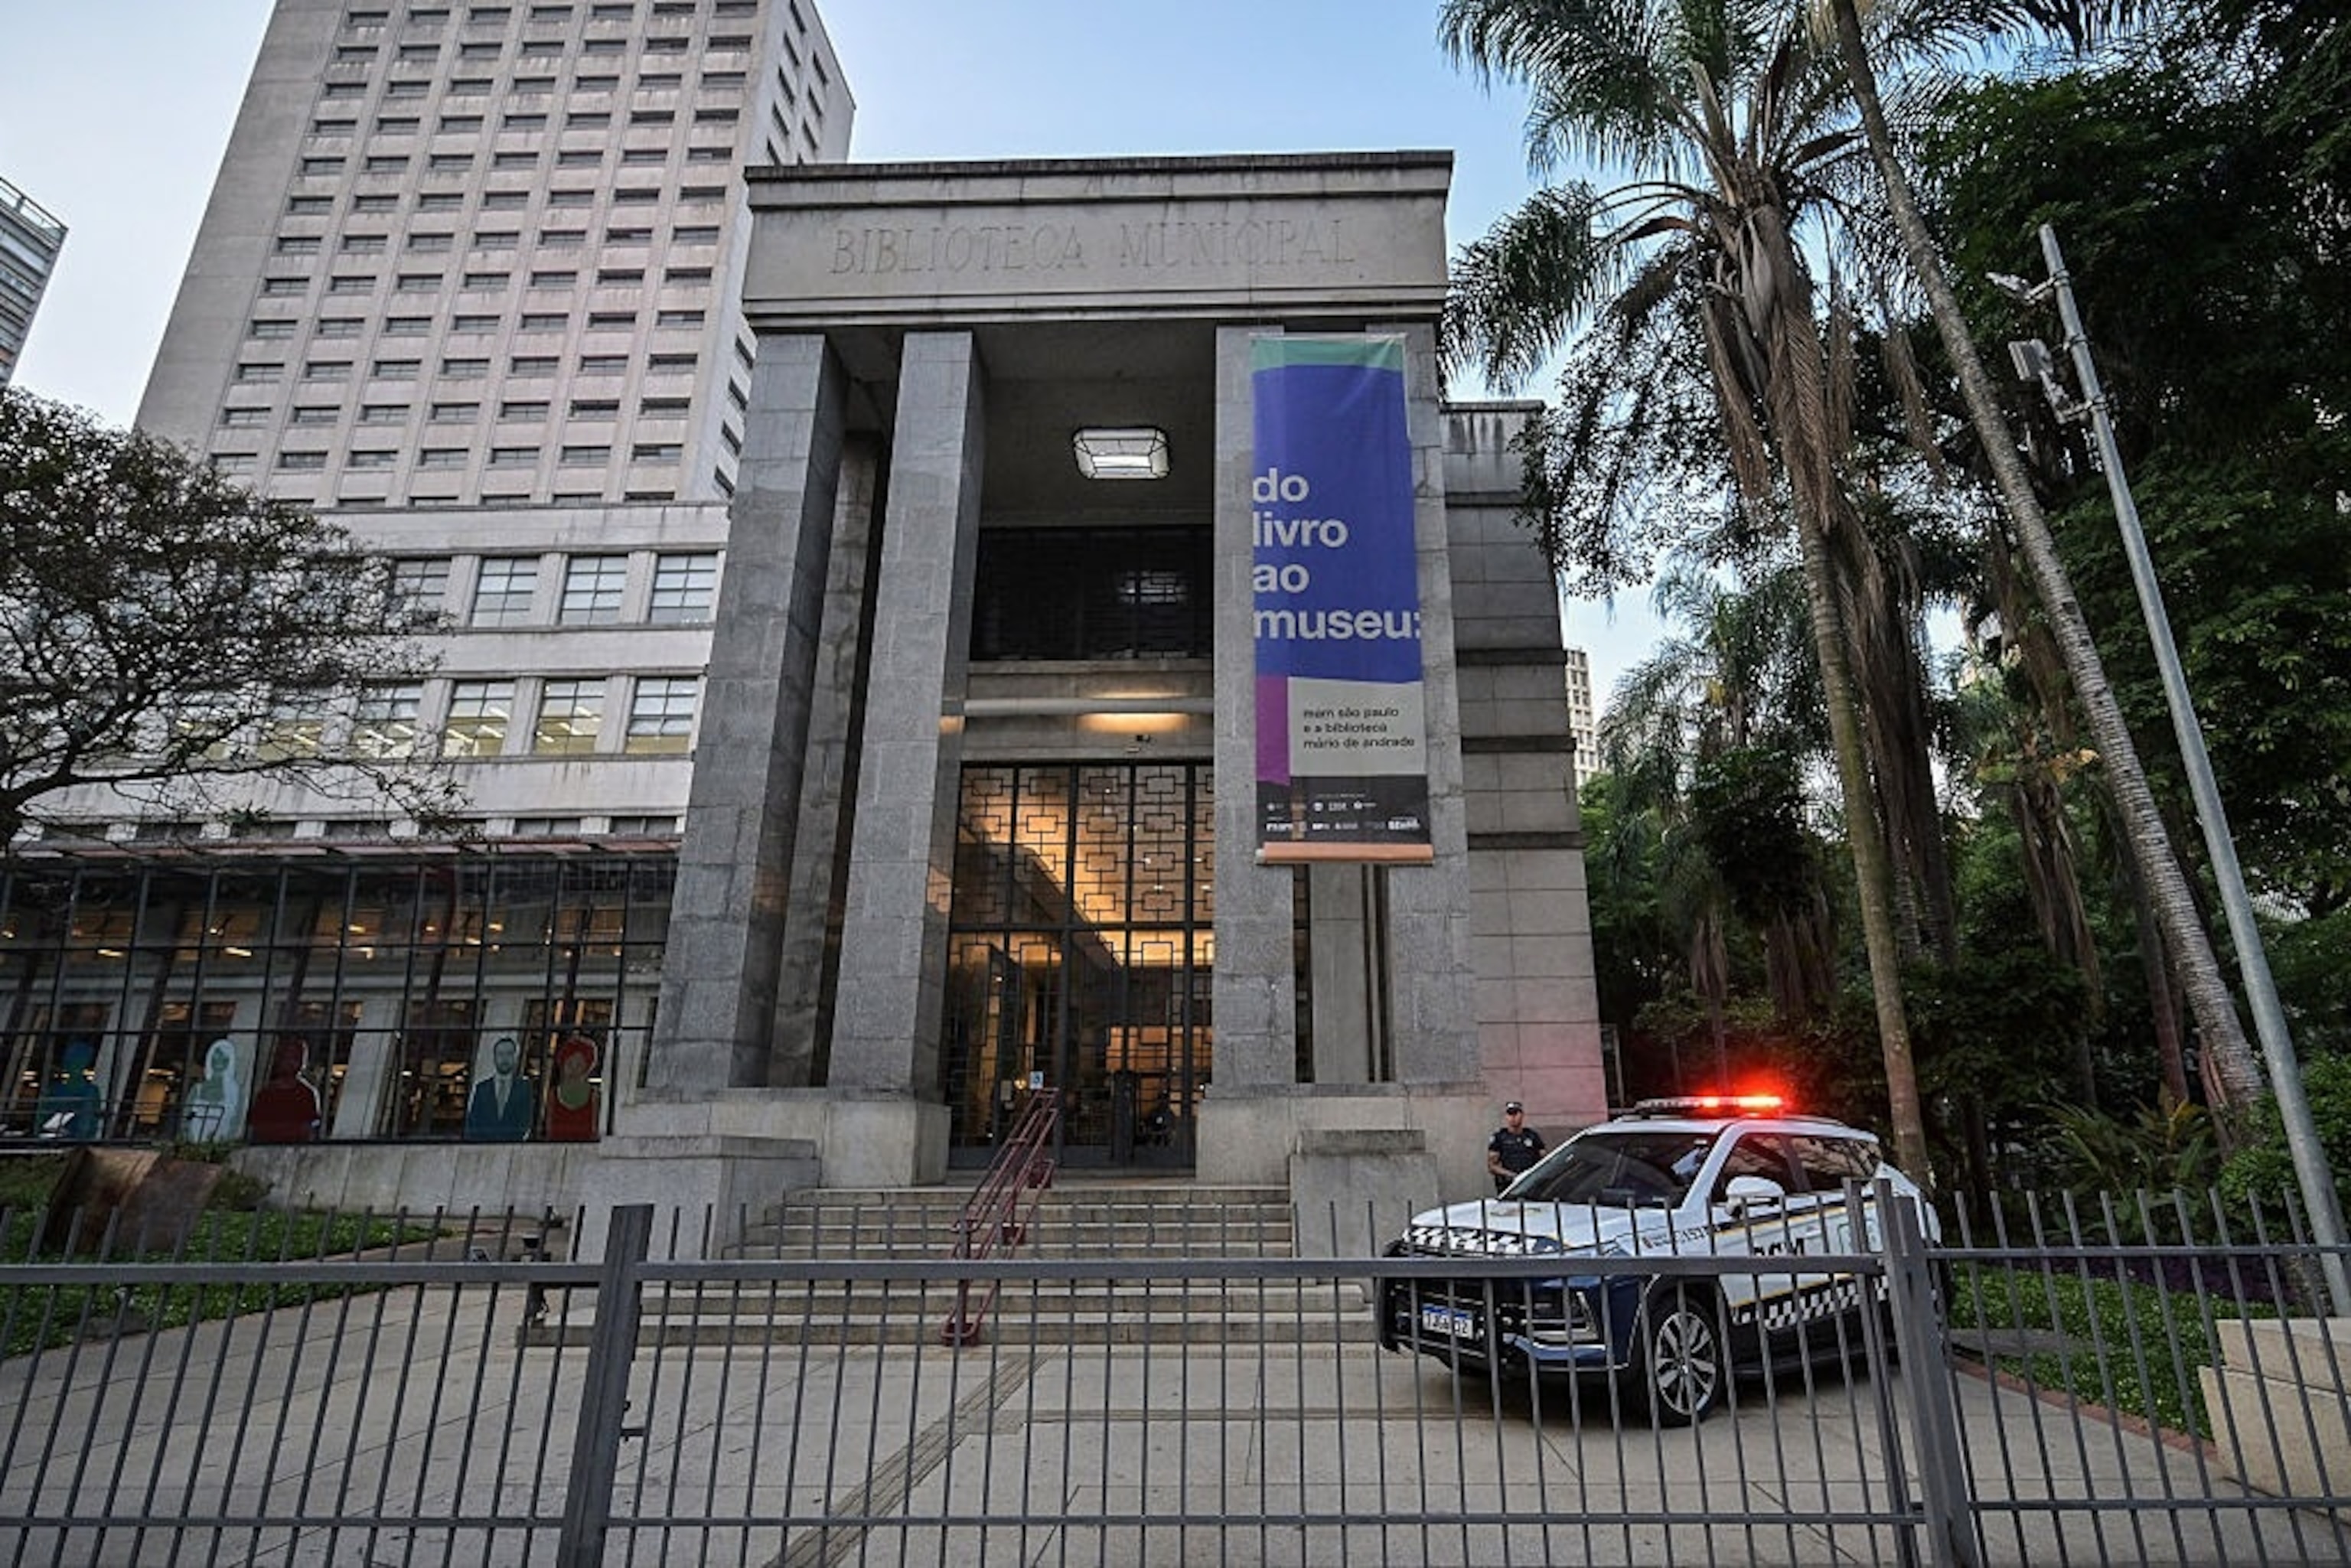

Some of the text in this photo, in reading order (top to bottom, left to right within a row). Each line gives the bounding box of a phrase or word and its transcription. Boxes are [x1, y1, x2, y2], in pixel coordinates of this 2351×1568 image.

[830, 219, 1355, 274] BIBLIOTECA MUNICIPAL
[1253, 468, 1309, 502] do
[1253, 511, 1348, 548] livro
[1253, 563, 1309, 593] ao
[1325, 722, 1387, 733] biblioteca
[1364, 708, 1399, 719] paulo
[1343, 737, 1359, 748] de
[1363, 736, 1415, 748] andrade
